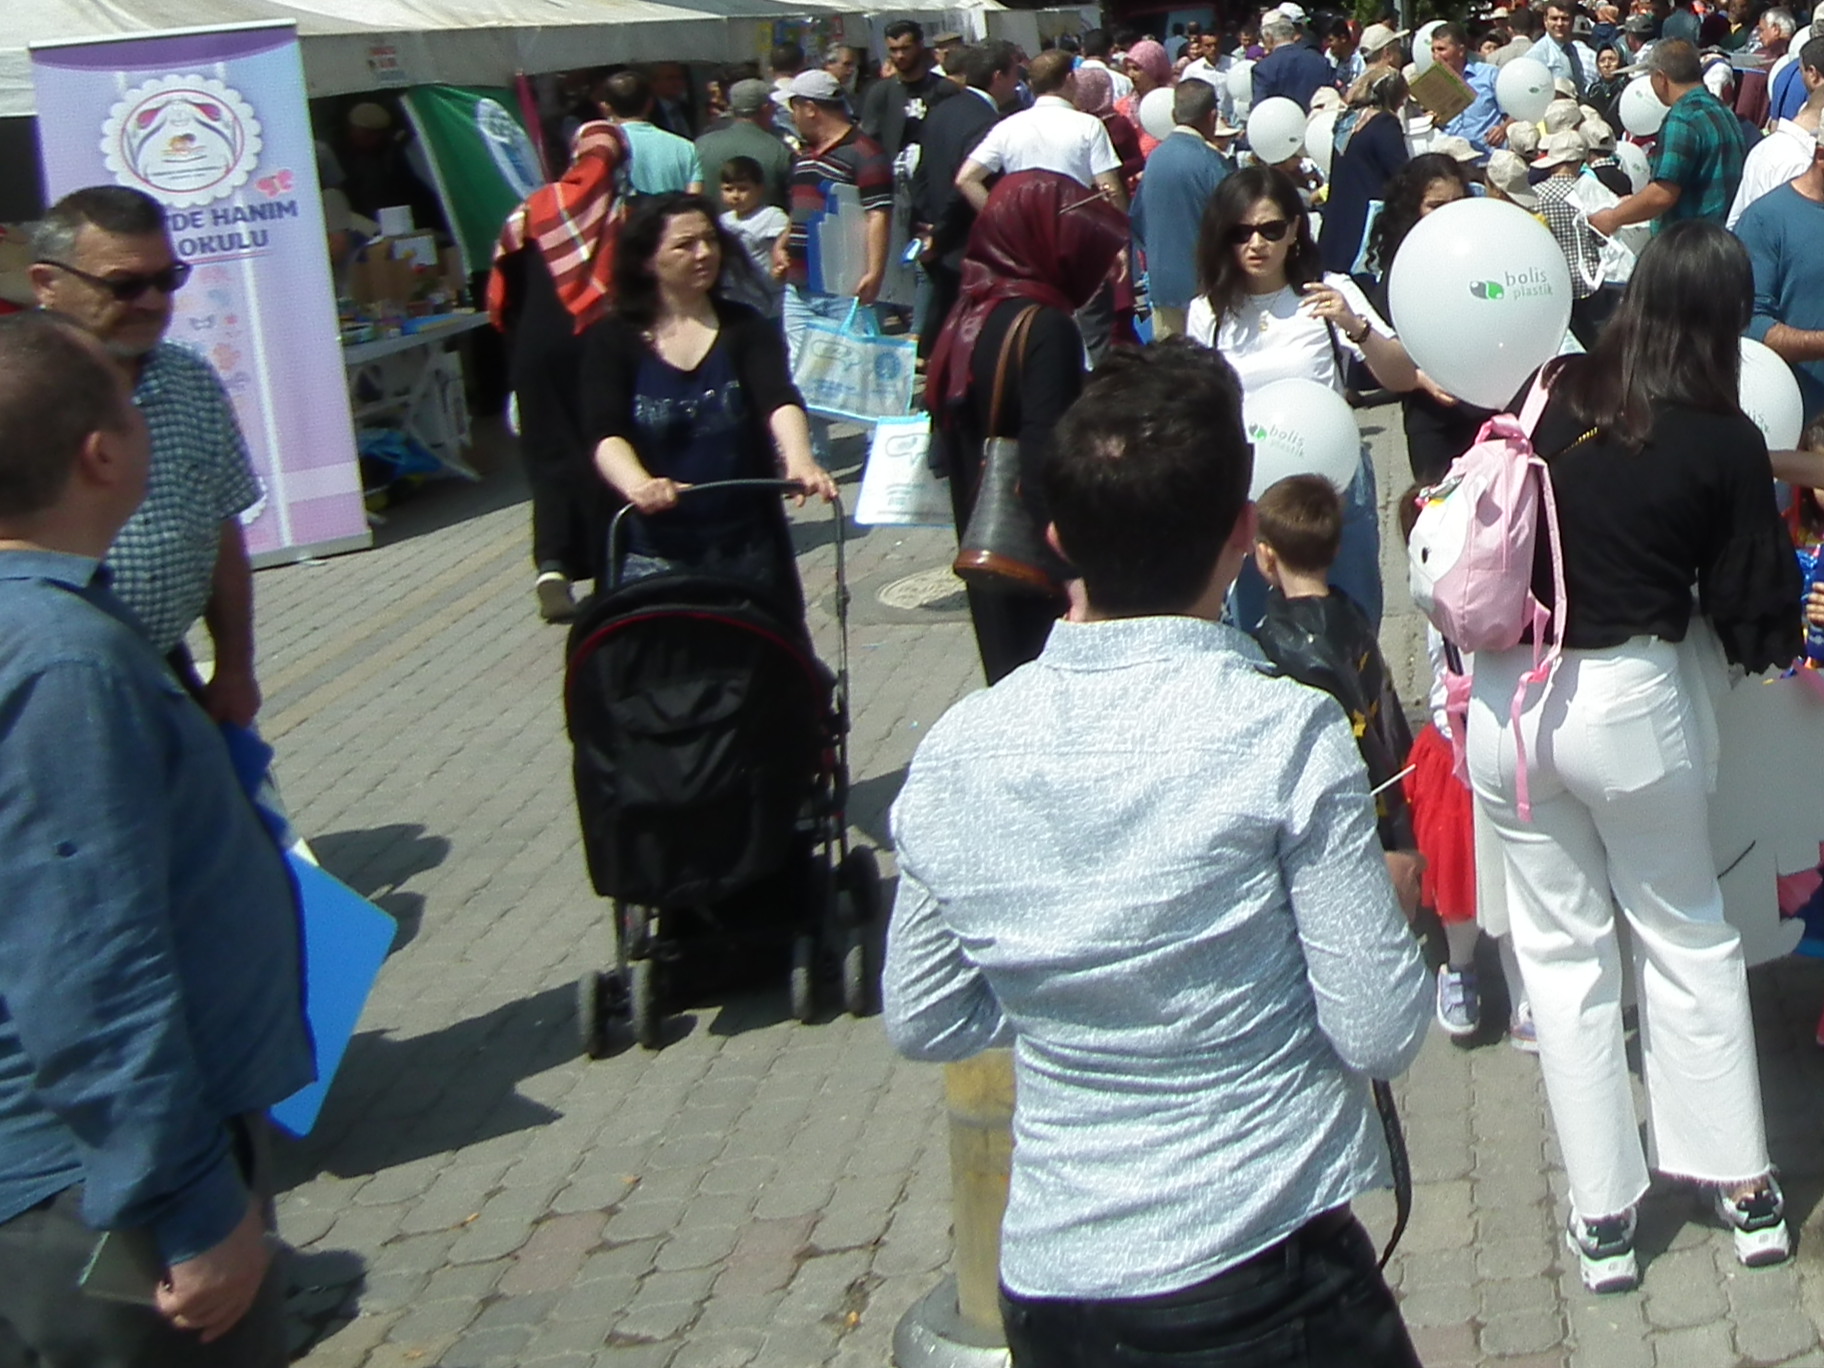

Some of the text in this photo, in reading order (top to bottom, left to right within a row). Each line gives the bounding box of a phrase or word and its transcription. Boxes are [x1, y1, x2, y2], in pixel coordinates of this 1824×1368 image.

[210, 200, 299, 227] HANIM
[178, 230, 269, 256] OKULU
[1505, 266, 1547, 287] bolis
[1513, 282, 1553, 301] plastik
